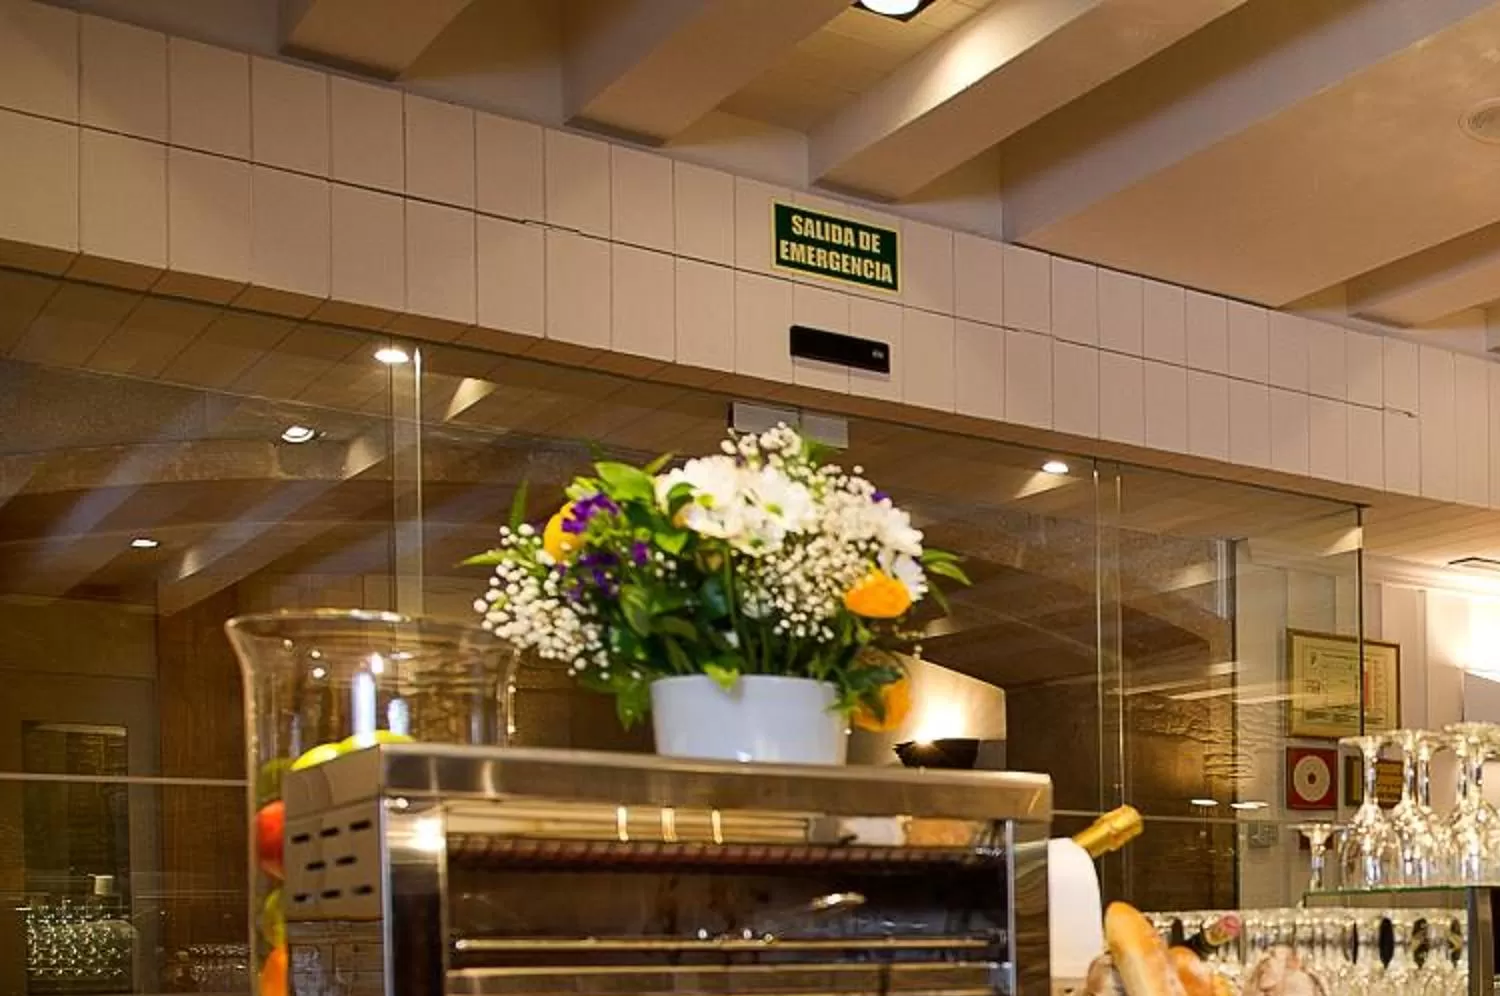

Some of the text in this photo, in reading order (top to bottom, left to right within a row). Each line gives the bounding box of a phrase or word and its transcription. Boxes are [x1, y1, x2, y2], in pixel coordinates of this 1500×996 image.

[791, 215, 881, 253] SALIDA DE
[779, 239, 893, 283] EMERGENCIA
